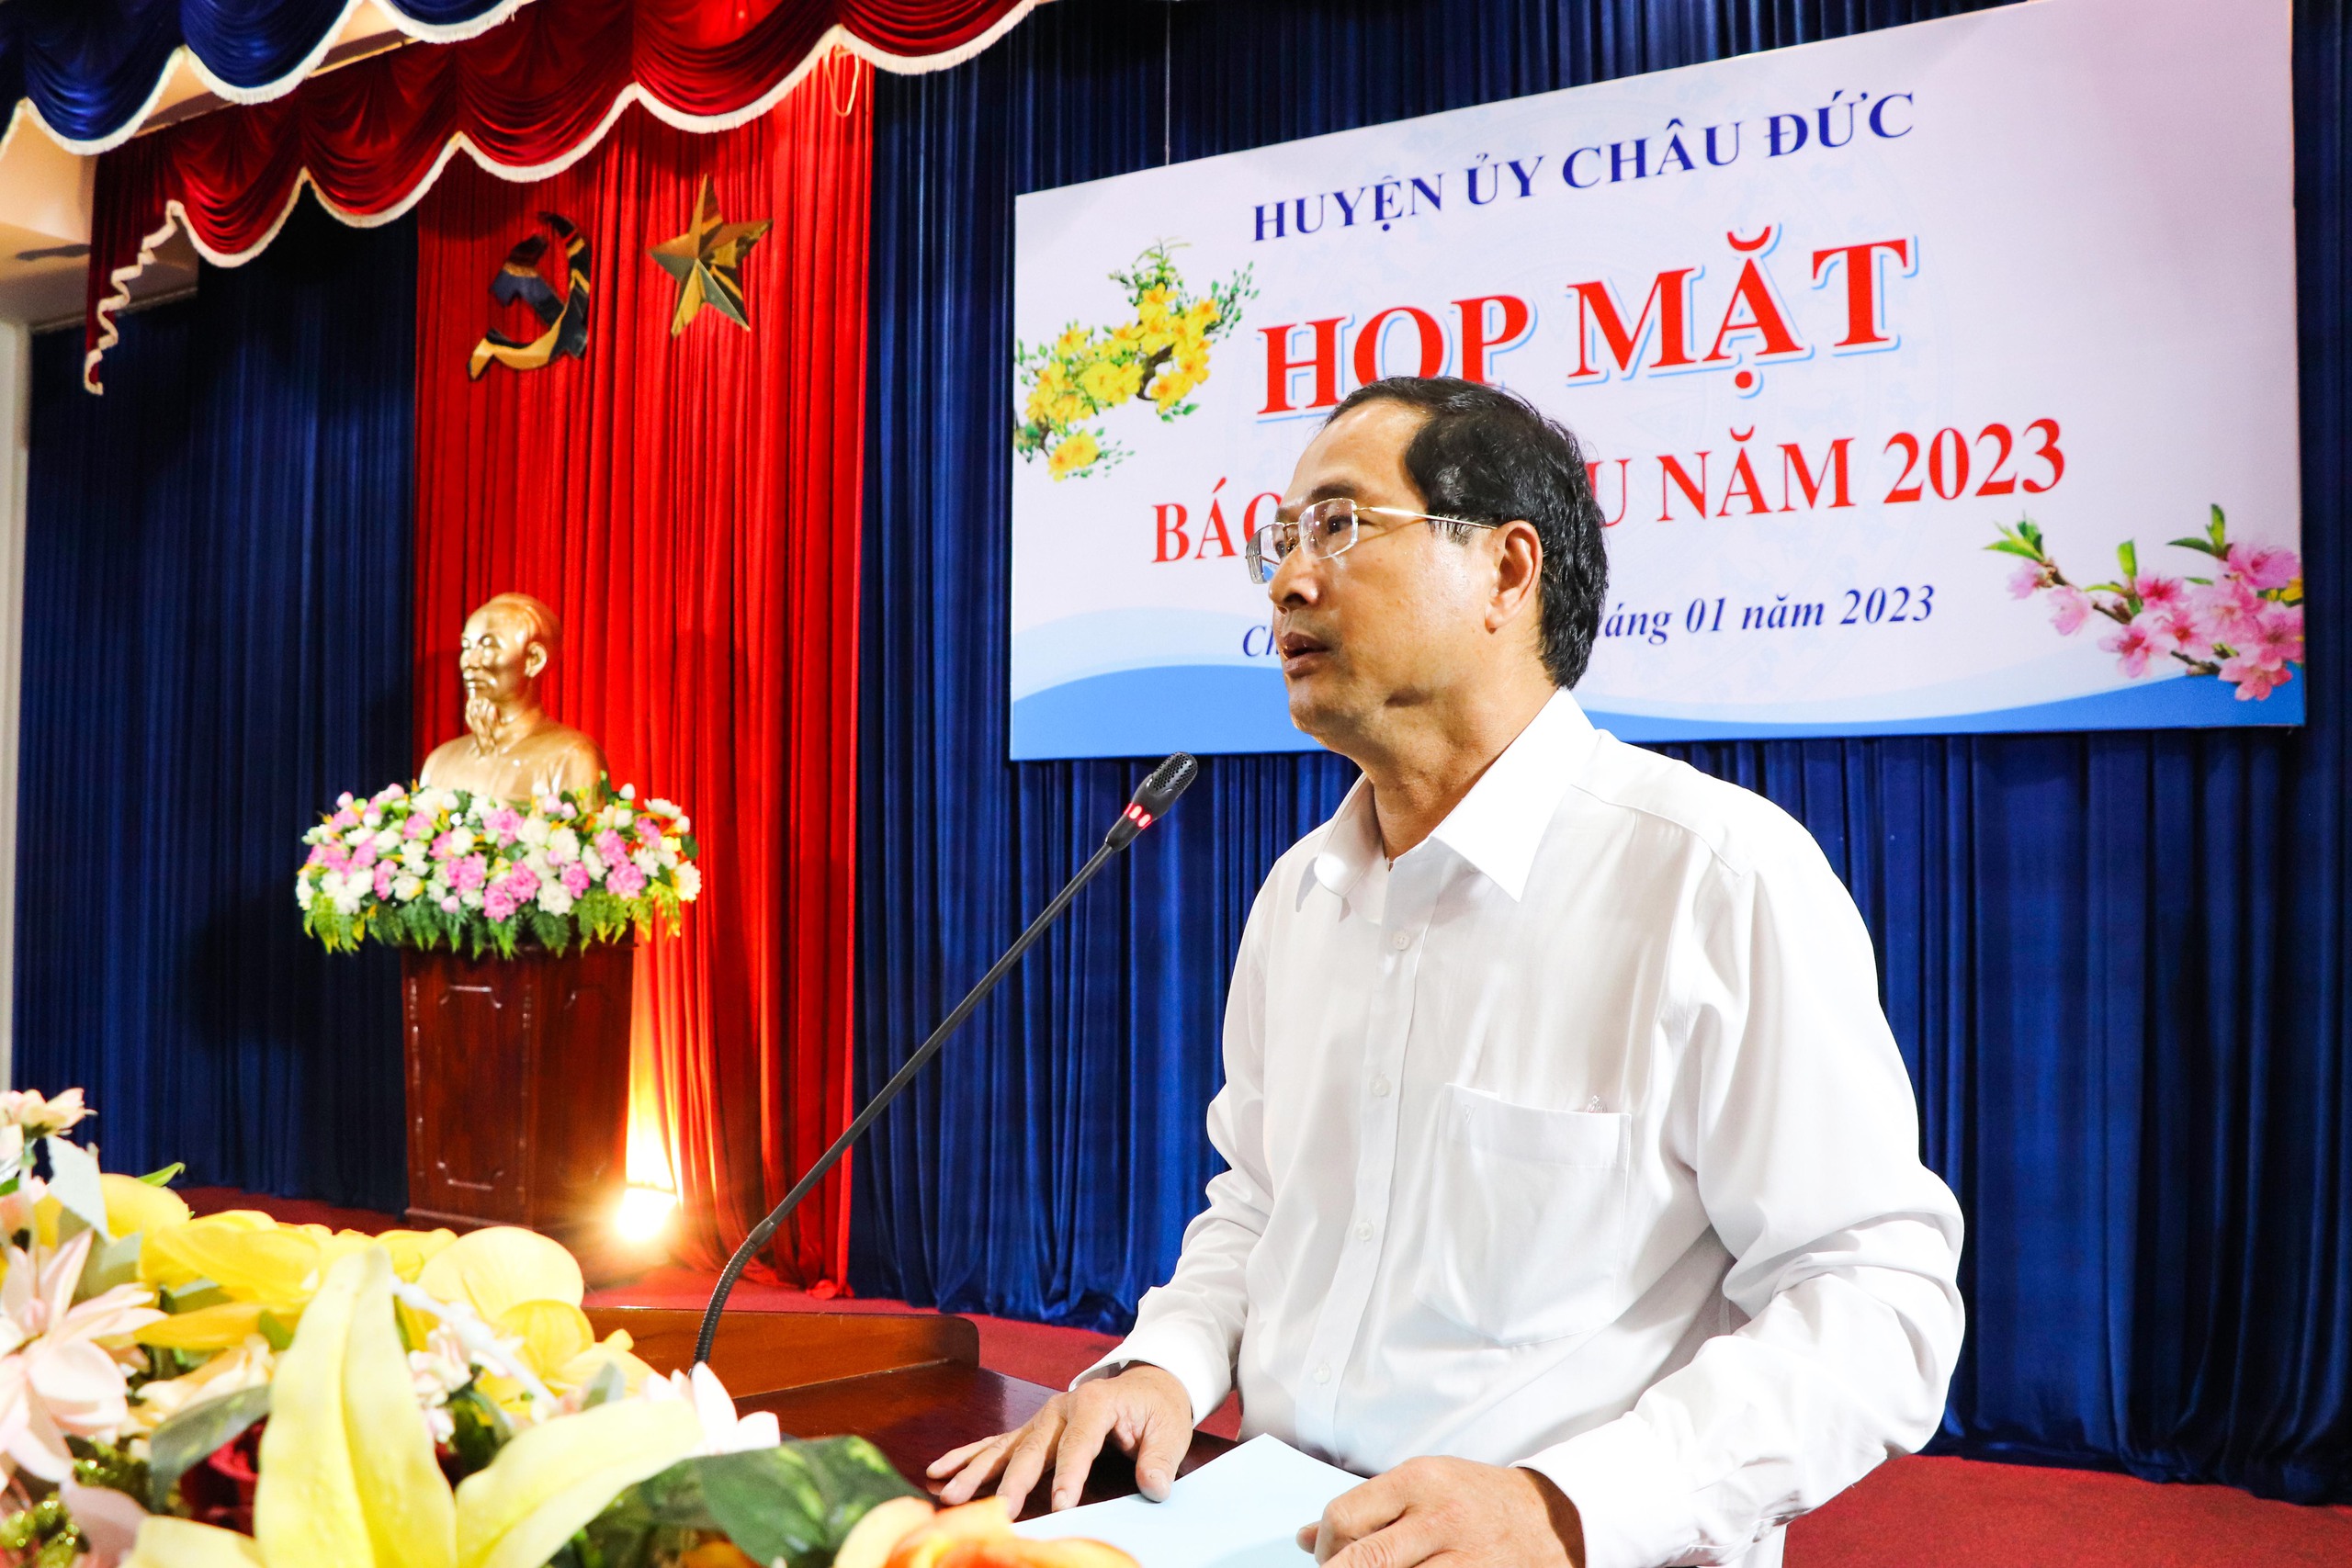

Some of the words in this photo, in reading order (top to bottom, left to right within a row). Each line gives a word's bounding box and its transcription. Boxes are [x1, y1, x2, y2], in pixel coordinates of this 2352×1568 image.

[1253, 175, 1444, 242] HUYỆN
[1466, 152, 1544, 206] ỦY
[1562, 117, 1741, 189] CHÂU
[1766, 88, 1915, 157] ĐỨC
[1567, 226, 1908, 389] MẶT
[1657, 425, 1856, 522] NĂM
[1883, 418, 2065, 504] 2023
[1597, 603, 1672, 645] áng
[1686, 597, 1726, 633] 01
[1741, 595, 1825, 631] năm
[1840, 585, 1935, 626] 2023
